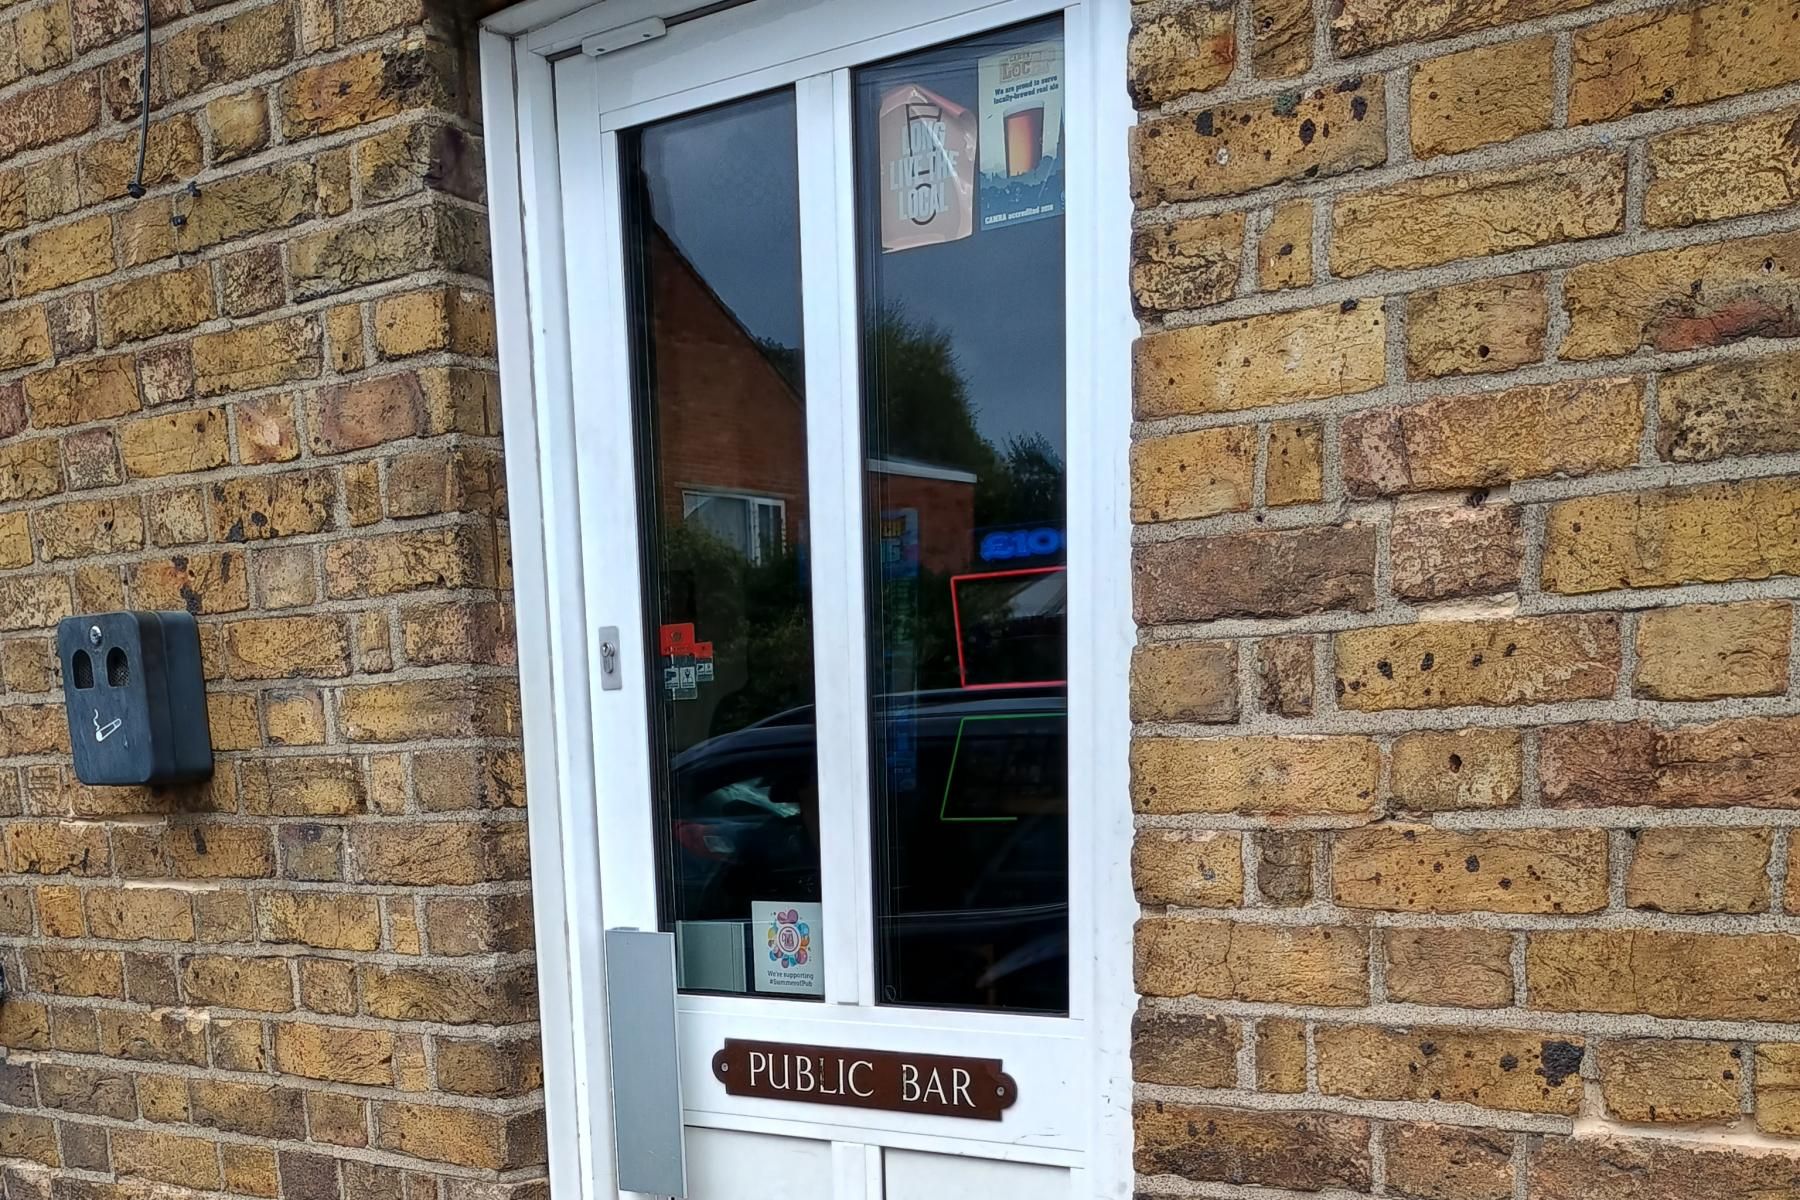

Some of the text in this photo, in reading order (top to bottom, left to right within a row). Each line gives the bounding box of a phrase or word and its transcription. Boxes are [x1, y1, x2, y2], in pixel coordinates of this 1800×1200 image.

[993, 83, 1059, 104] locally-brewed real ale
[1005, 85, 1015, 93] are
[1016, 80, 1033, 92] proud
[1033, 79, 1040, 87] to
[1041, 75, 1058, 84] serve
[902, 121, 946, 156] LONG
[890, 151, 959, 190] LIVE THE
[899, 183, 948, 219] LOCAL
[984, 213, 1007, 225] CAMRA
[1007, 205, 1040, 220] accredited
[980, 526, 1064, 561] £10
[767, 970, 814, 980] We're supporting
[748, 1051, 976, 1108] PUBLIC BAR
